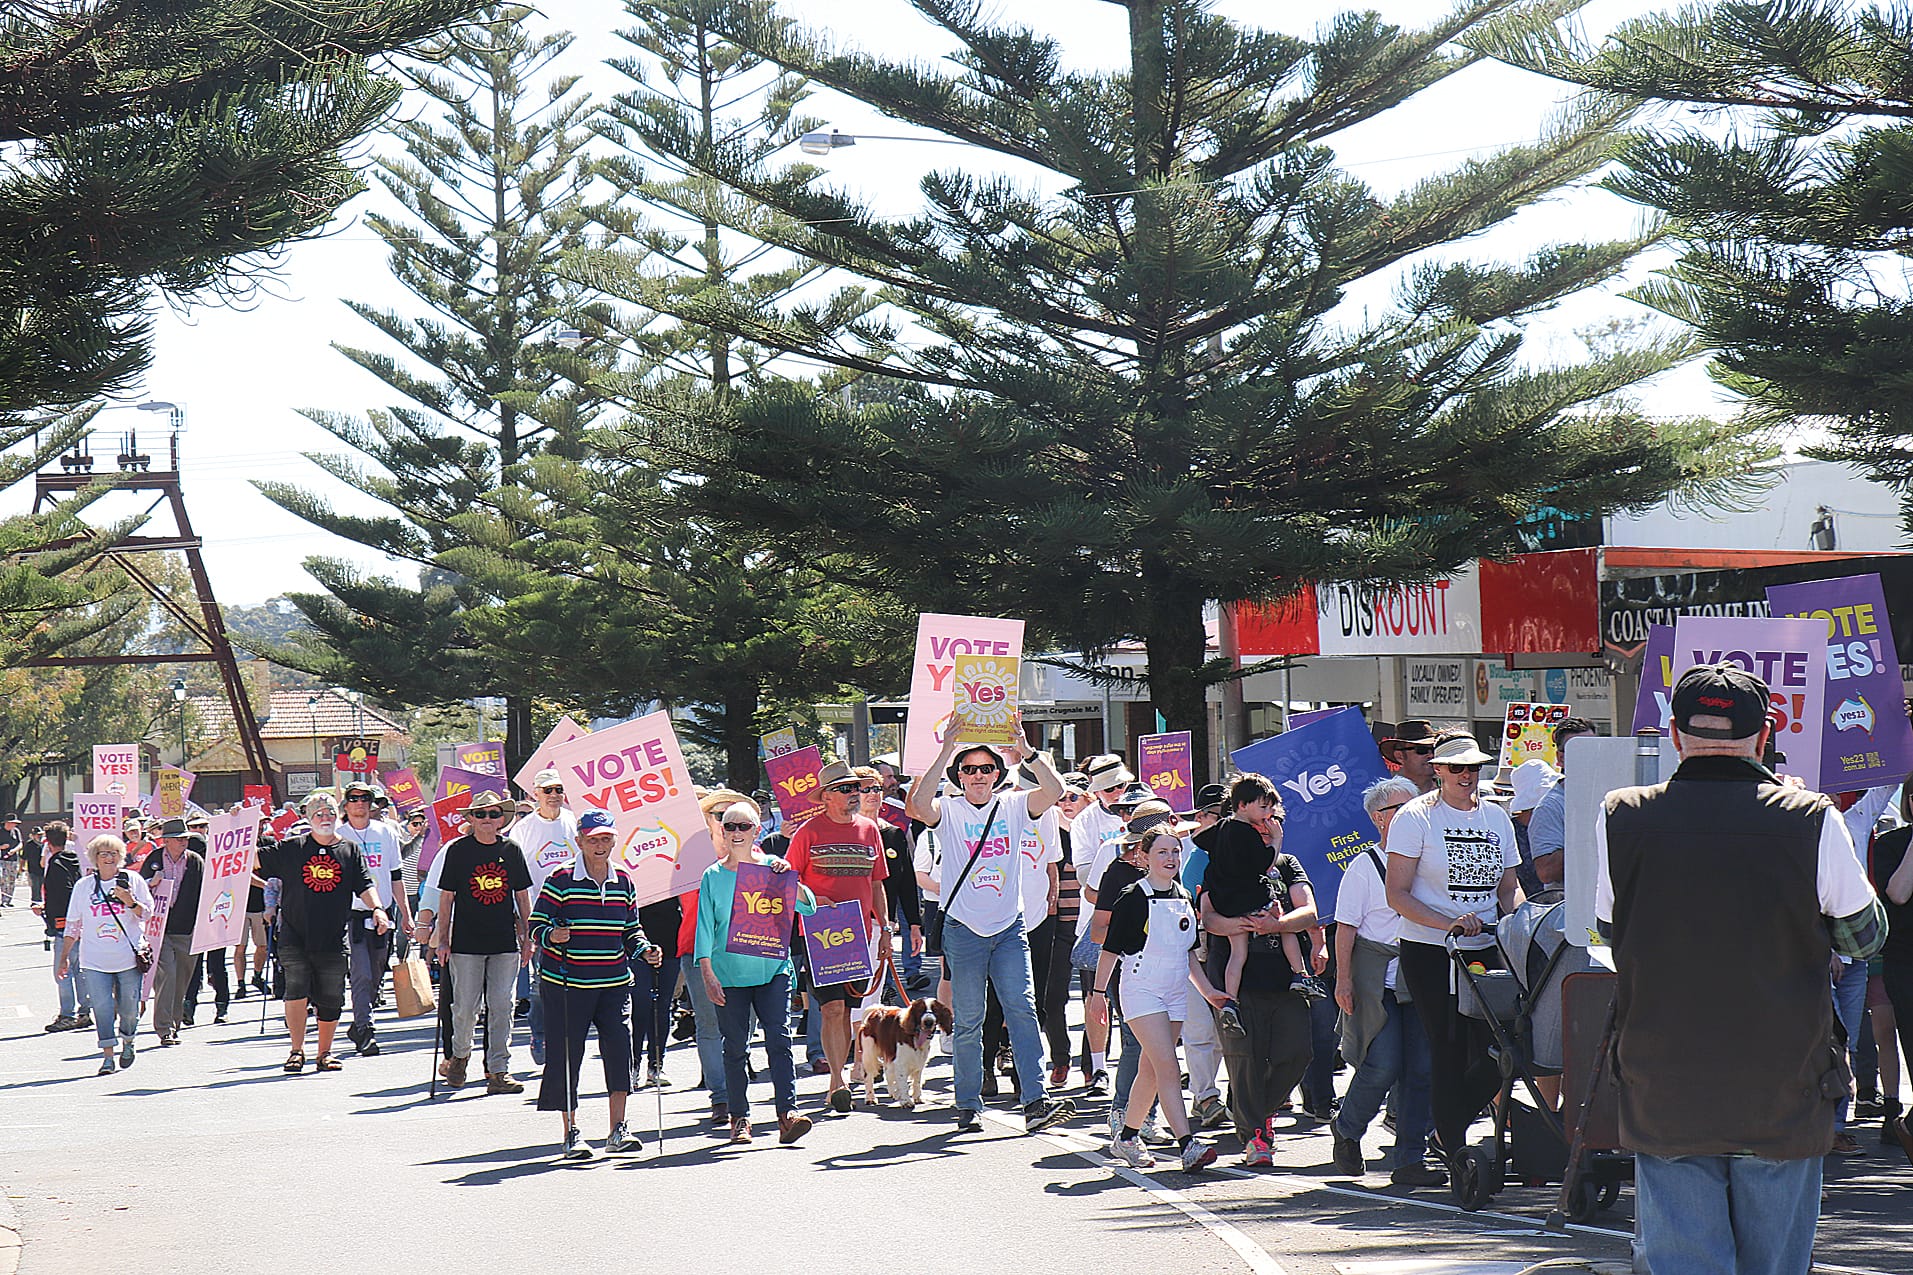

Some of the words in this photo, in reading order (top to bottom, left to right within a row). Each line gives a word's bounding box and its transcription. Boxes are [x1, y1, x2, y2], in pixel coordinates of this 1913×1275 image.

[1339, 580, 1450, 637] DISKOUNT
[1826, 639, 1886, 681] ES!
[1411, 664, 1436, 682] LOCALLY
[1438, 664, 1461, 682] OWNED!
[962, 681, 1006, 704] Yes
[1410, 686, 1431, 704] FAMILY
[1432, 686, 1464, 704] OPERATED!
[1049, 707, 1084, 715] Crugnale
[1840, 710, 1866, 722] yes23
[342, 739, 379, 755] VOTE
[769, 743, 791, 756] Yes
[1524, 740, 1543, 752] Yes
[100, 753, 133, 763] VOTE
[347, 756, 368, 770] YES
[462, 750, 500, 764] VOTE
[571, 738, 668, 788] VOTE
[100, 764, 133, 775] YES!
[389, 781, 413, 794] Yes
[778, 772, 818, 798] Yes
[1149, 769, 1187, 791] Yes
[1281, 764, 1348, 804] Yes
[582, 767, 680, 813] YES!
[79, 803, 116, 815] VOTE
[247, 797, 266, 807] Yes
[79, 817, 116, 830] YES!
[214, 826, 253, 853] VOTE
[633, 836, 669, 856] yes23
[1330, 830, 1361, 848] First
[544, 850, 569, 860] yes23
[964, 837, 1010, 858] YES!
[211, 849, 249, 880] YES!
[309, 865, 335, 879] Yes
[475, 875, 503, 891] Yes
[90, 903, 126, 917] YES!
[215, 901, 230, 914] yes23
[742, 891, 783, 915] Yes
[812, 927, 856, 950] Yes
